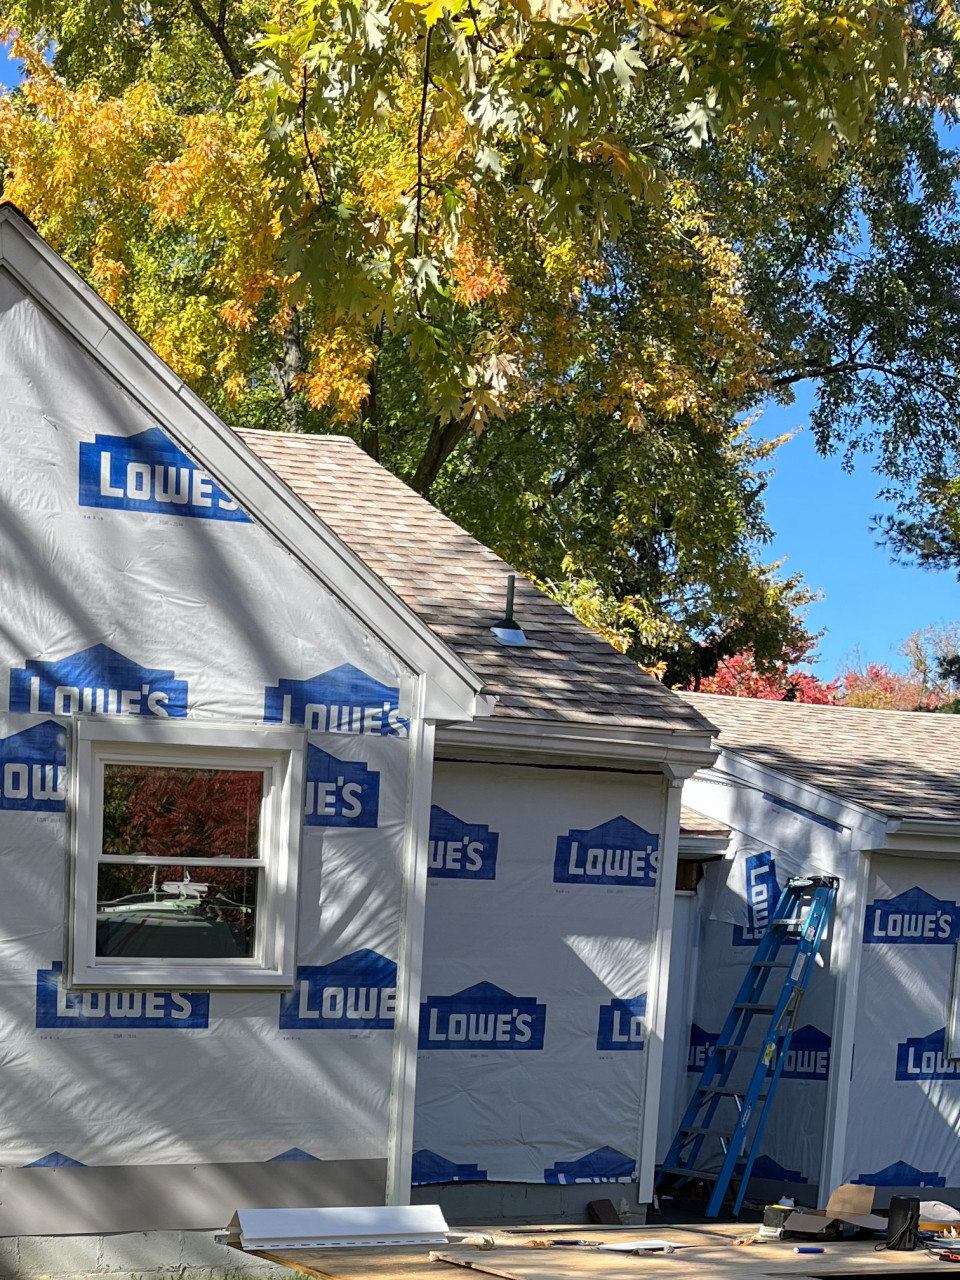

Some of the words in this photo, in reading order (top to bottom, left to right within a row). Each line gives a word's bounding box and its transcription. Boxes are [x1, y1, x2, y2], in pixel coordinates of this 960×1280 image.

[100, 451, 240, 511] LOWE
[30, 676, 169, 718] LOWE'S
[873, 909, 952, 938] LOWE'S
[298, 980, 397, 1019] LOWE
[428, 1007, 532, 1043] LOWE'S
